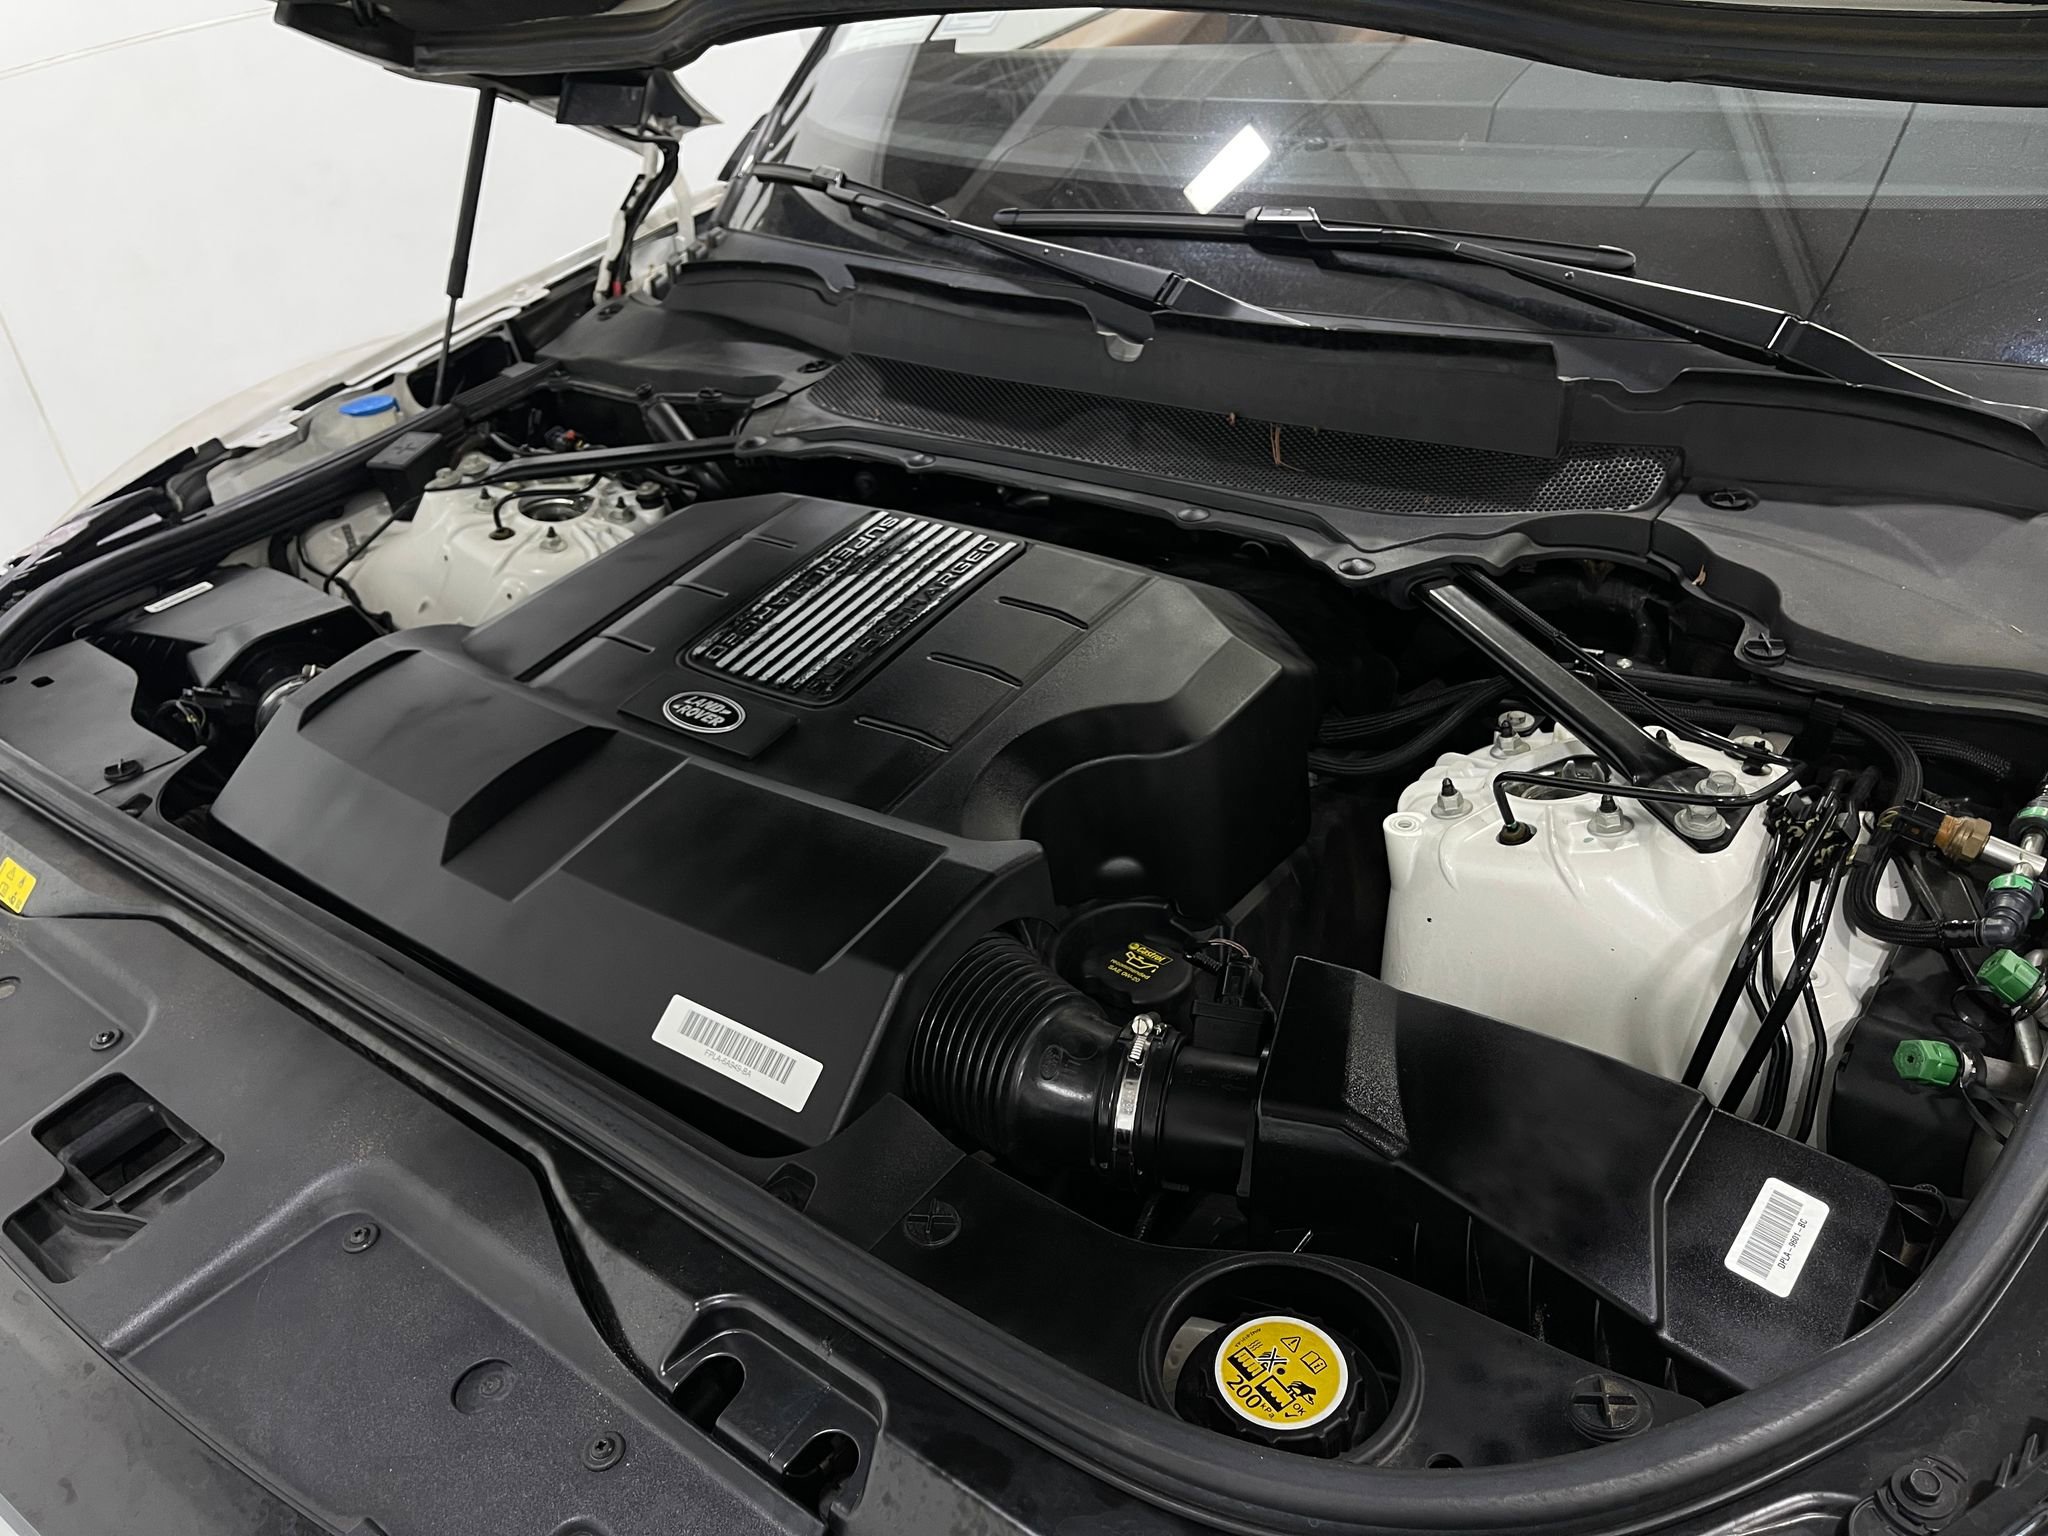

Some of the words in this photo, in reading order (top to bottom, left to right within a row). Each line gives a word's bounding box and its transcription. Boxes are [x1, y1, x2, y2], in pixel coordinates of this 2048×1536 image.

[705, 516, 900, 660] SUPERCHARGED
[807, 540, 1000, 692] SUPERCHARGED
[683, 695, 725, 713] LAND
[678, 704, 725, 728] ROVER
[1136, 946, 1166, 963] Castrol
[1108, 964, 1122, 974] SAE
[1120, 971, 1141, 983] 0W-20
[1226, 1374, 1262, 1409] 200
[1260, 1403, 1275, 1419] kPa
[1292, 1402, 1307, 1416] OK
